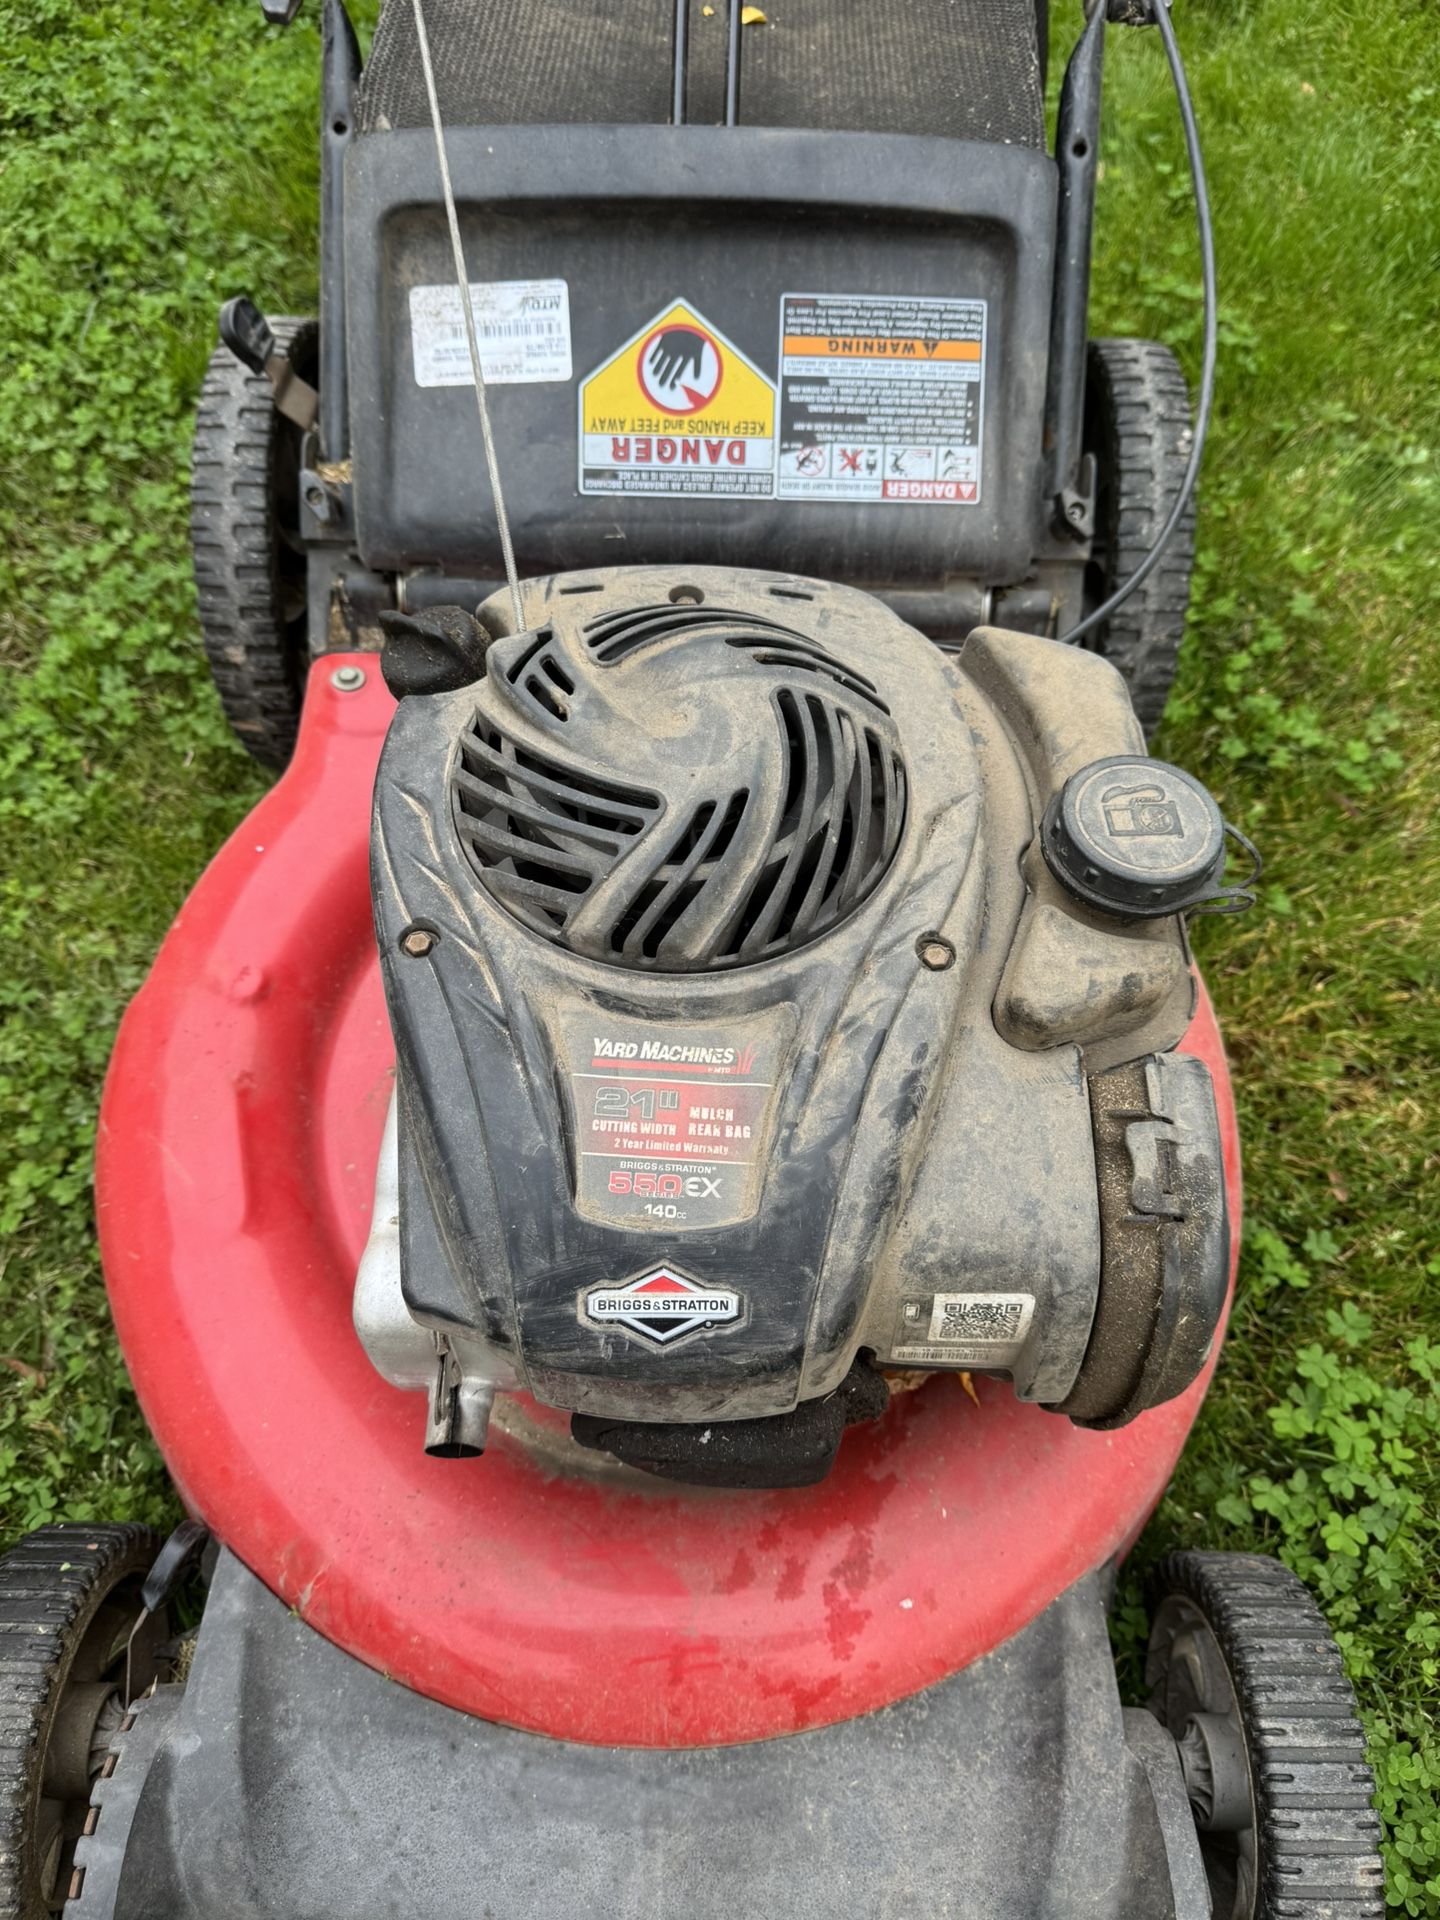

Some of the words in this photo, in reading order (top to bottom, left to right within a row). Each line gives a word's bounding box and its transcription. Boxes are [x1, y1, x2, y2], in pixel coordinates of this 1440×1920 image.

[827, 340, 916, 355] WARNING
[590, 418, 627, 431] AWAY
[631, 418, 659, 432] FEET
[663, 419, 684, 432] and
[688, 419, 729, 433] HANDS
[734, 421, 765, 434] KEEP
[611, 438, 746, 465] DANGER
[887, 482, 956, 498] DANGER
[594, 1086, 679, 1120] 21"
[690, 1107, 734, 1121] MULCH
[592, 1119, 638, 1133] CUTTING
[640, 1121, 676, 1136] WIDTH
[688, 1124, 721, 1137] REAR
[725, 1124, 751, 1138] BAG
[614, 1138, 620, 1147] 2
[623, 1138, 644, 1149] Year
[646, 1140, 681, 1152] Limited
[684, 1142, 729, 1156] Warranty
[598, 1299, 729, 1311] BRIGGS&STRATTON
